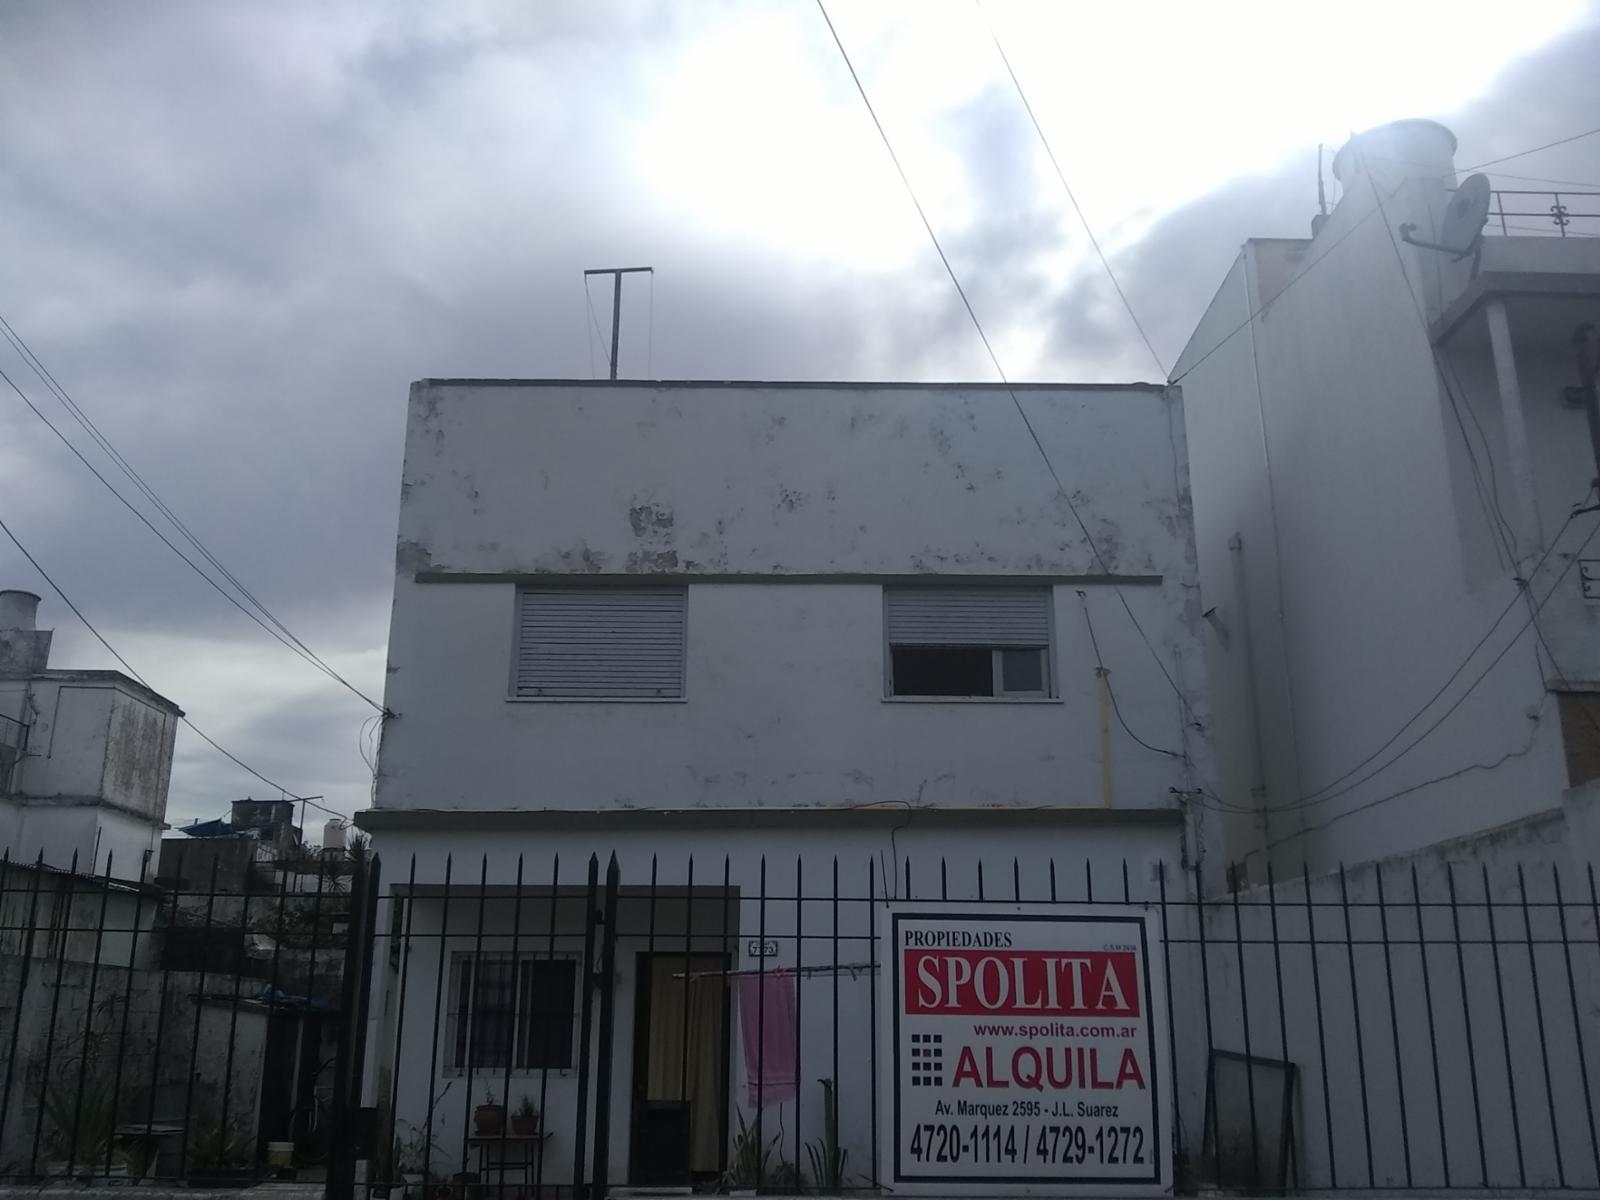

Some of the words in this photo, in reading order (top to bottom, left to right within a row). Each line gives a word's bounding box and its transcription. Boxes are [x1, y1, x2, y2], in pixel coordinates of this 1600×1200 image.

[905, 931, 1012, 948] PROPIEDADES
[917, 955, 1131, 1011] SPOLITA
[974, 1024, 1137, 1040] www.spolita.com.ar
[952, 1046, 1145, 1092] ALQUILA
[935, 1100, 953, 1115] Av.
[957, 1101, 1008, 1119] Marquez
[1012, 1101, 1040, 1116] 2595
[1051, 1103, 1073, 1117] J.L.
[1077, 1103, 1119, 1117] Suarez
[910, 1123, 1017, 1163] 4720-1114
[1024, 1126, 1030, 1164] /
[1036, 1126, 1144, 1164] 4729-1272
